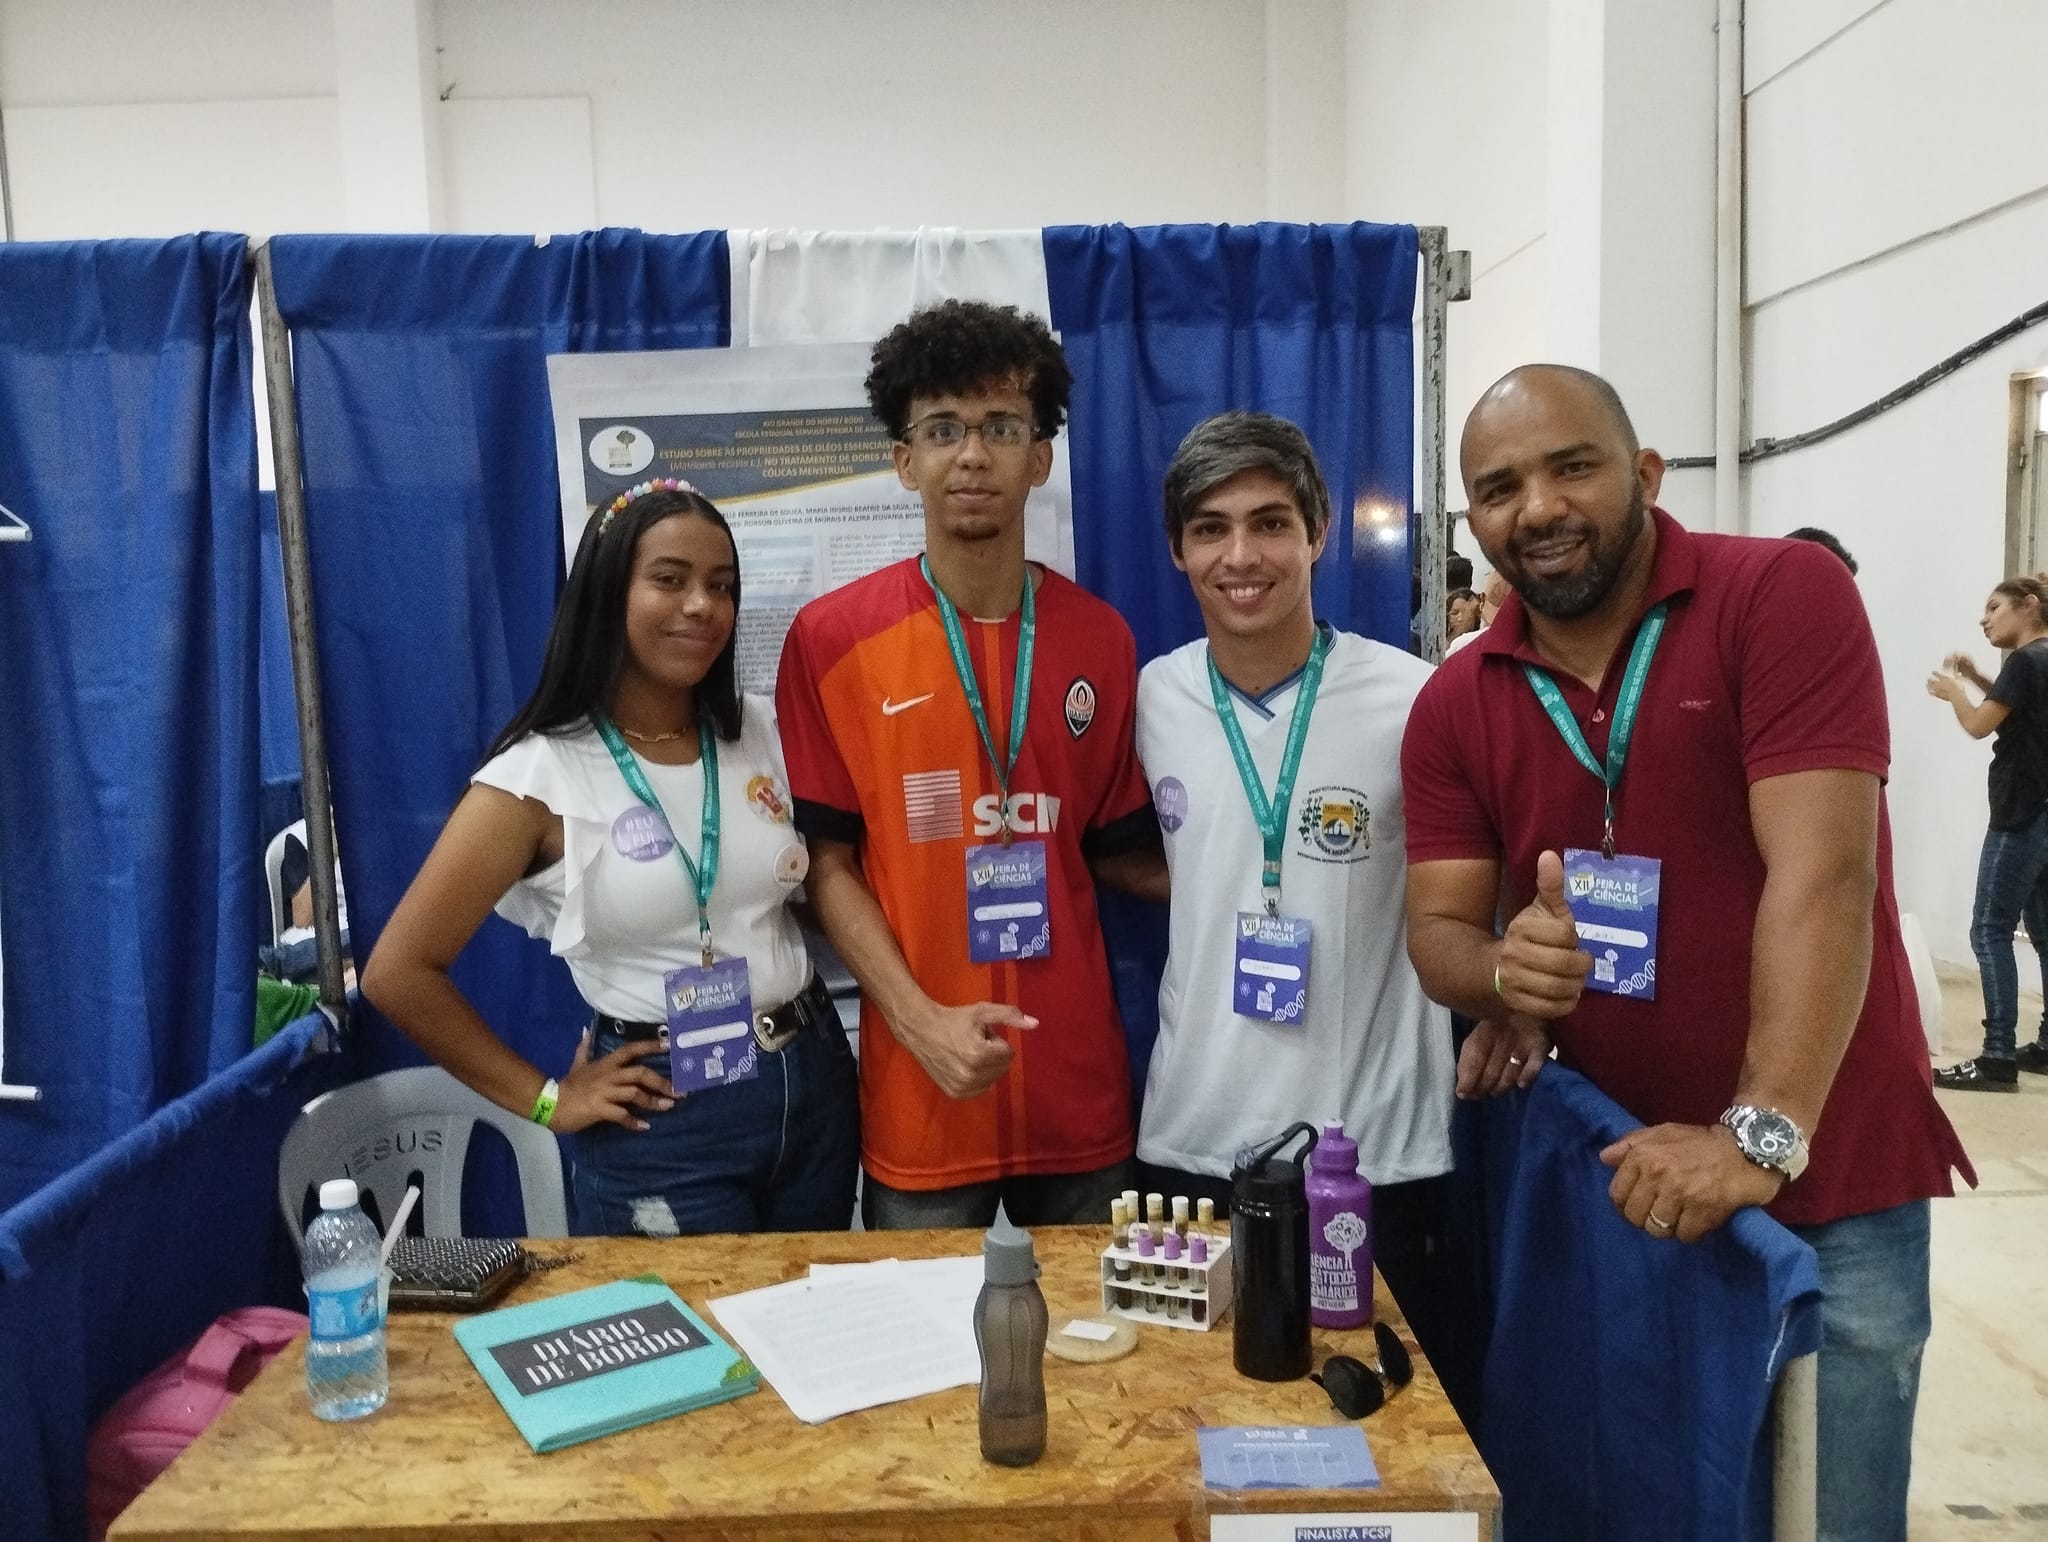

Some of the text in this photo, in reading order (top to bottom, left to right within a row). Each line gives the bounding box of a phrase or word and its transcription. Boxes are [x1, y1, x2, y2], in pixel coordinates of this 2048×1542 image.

[525, 1326, 691, 1387] DE BORDO
[532, 1317, 647, 1362] DIÁRIO
[1297, 1525, 1392, 1541] FINALISTA FCSP
